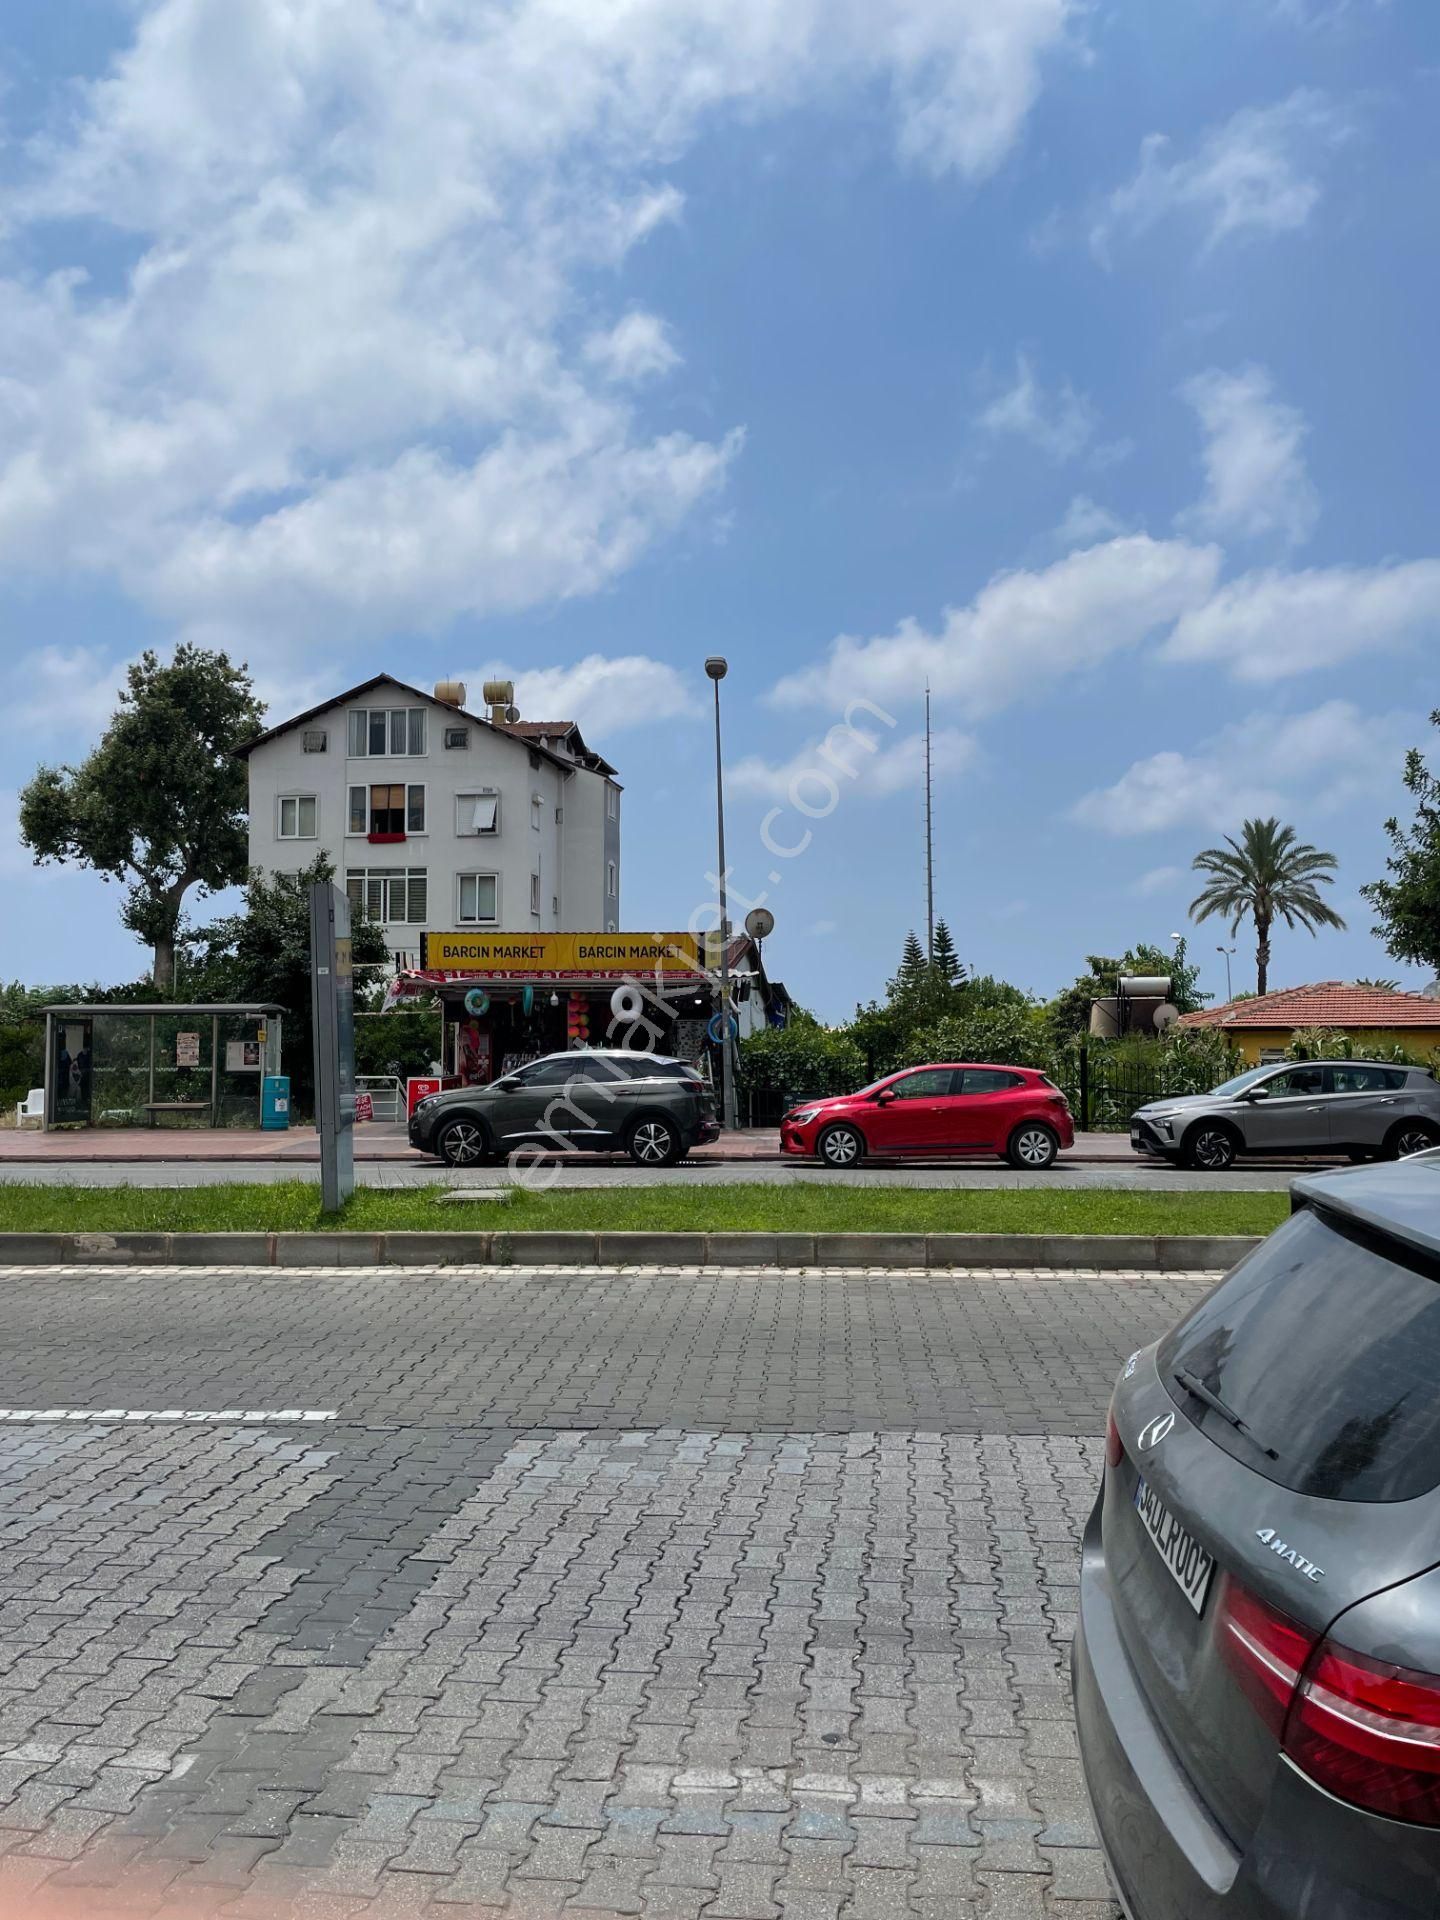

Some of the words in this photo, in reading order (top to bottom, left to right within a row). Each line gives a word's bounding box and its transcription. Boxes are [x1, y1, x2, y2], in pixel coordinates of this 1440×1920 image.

[443, 945, 490, 958] BARCIN
[493, 945, 546, 959] MARKET
[579, 946, 626, 958] BARCIN
[629, 946, 682, 958] MARKET
[1255, 1528, 1326, 1583] 4MATIC
